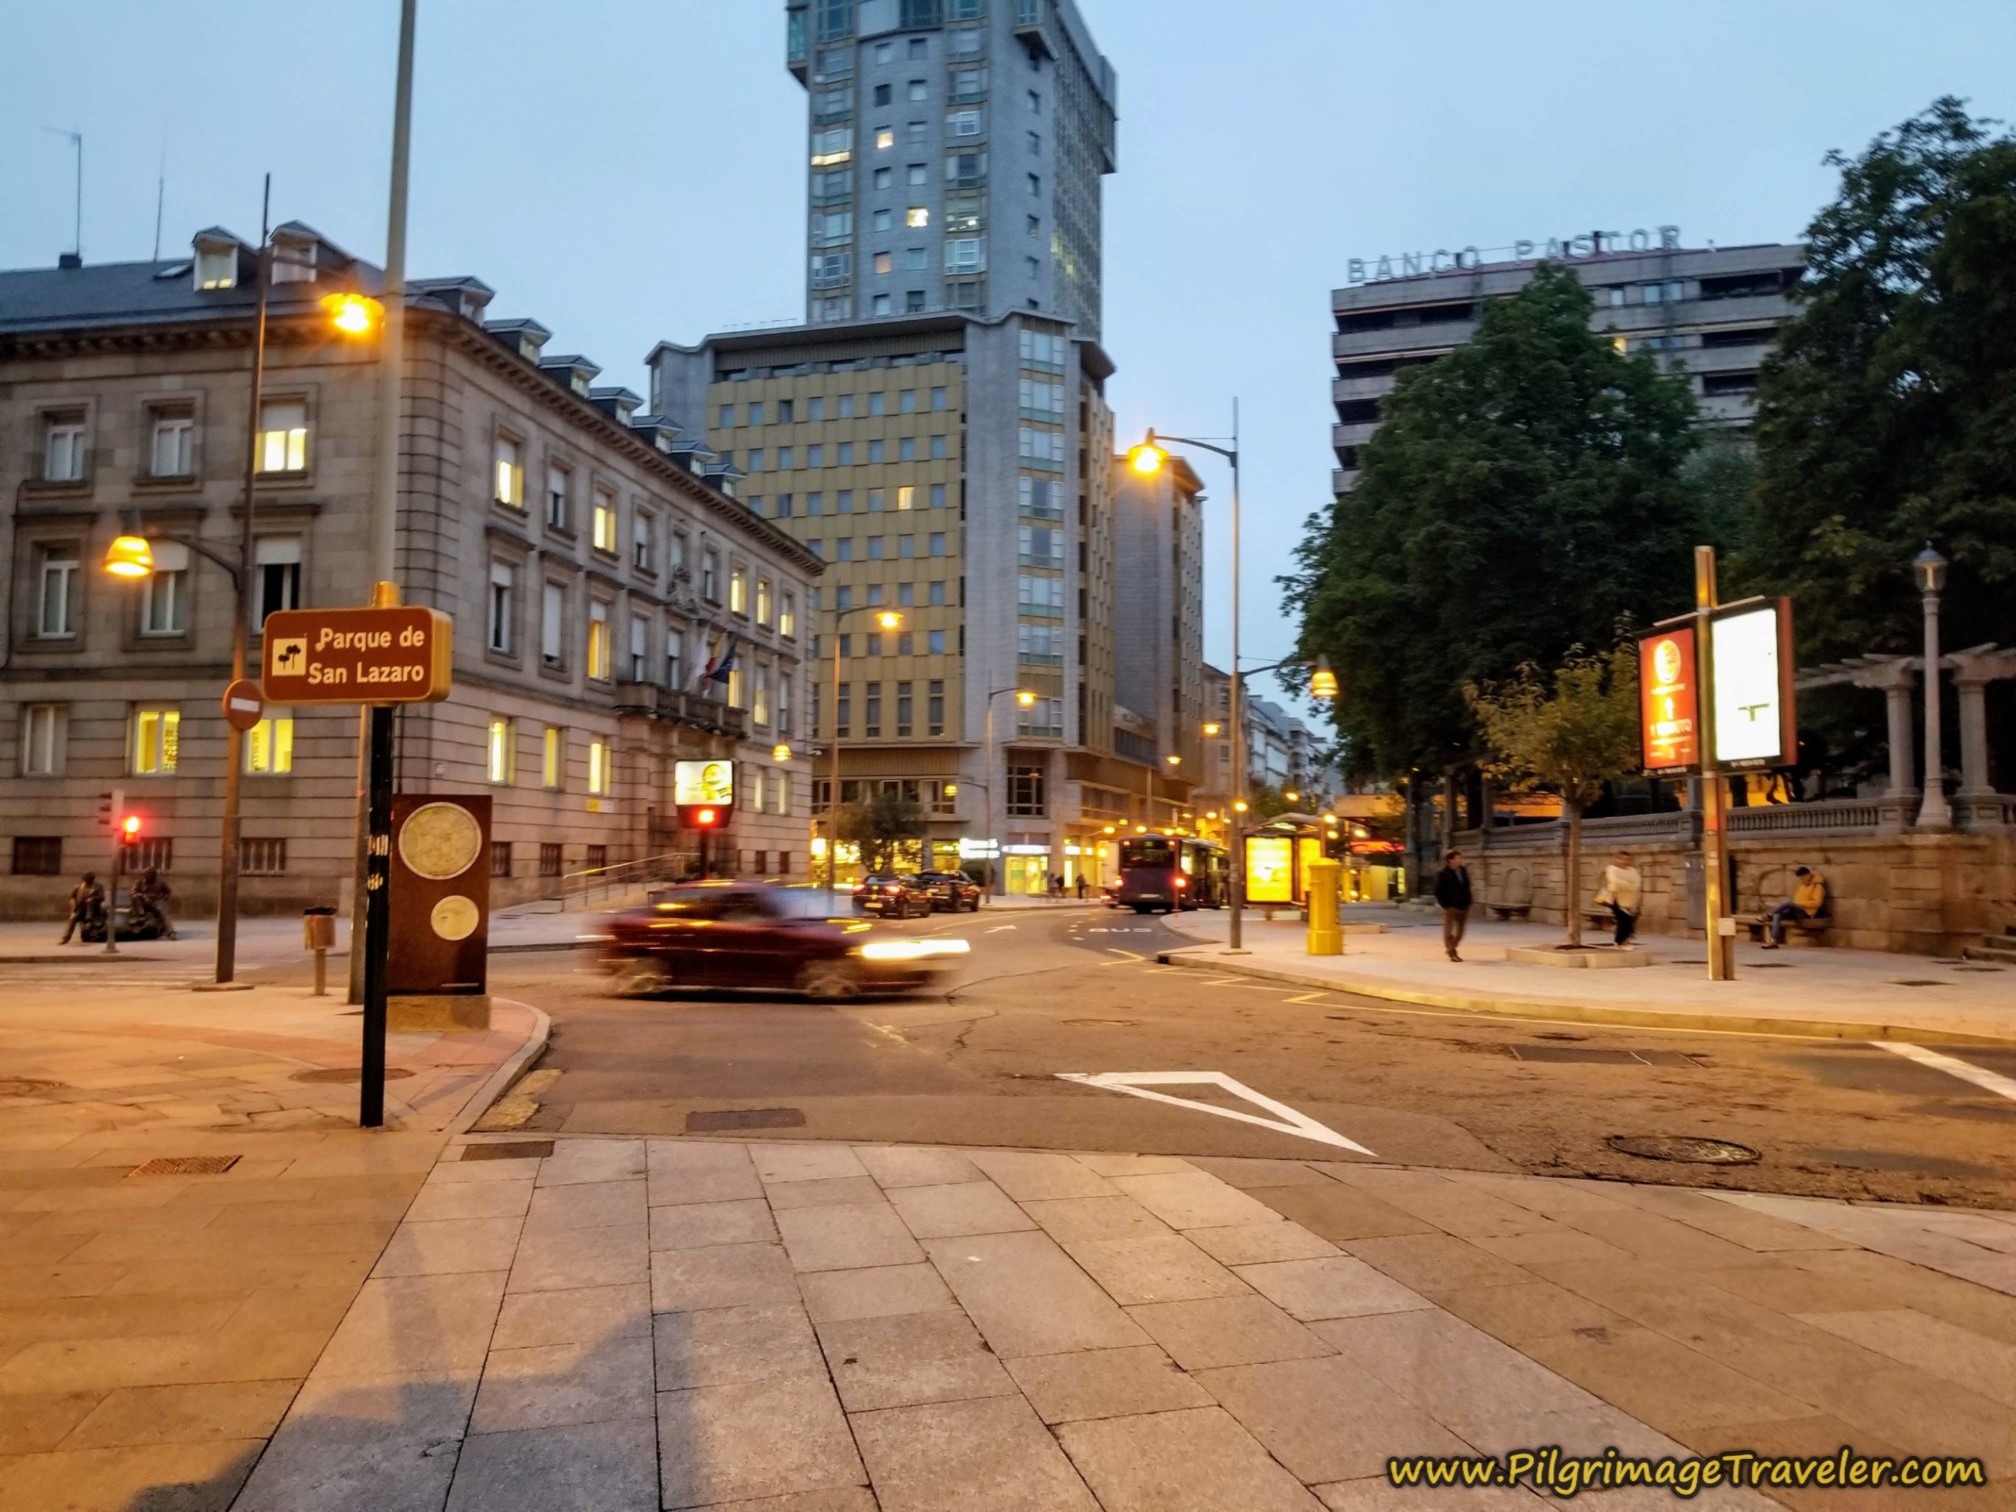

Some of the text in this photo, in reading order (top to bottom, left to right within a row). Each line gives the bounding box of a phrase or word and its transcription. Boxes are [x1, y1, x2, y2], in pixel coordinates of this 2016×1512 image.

[1347, 225, 1682, 284] BANCO PASTOR
[317, 625, 425, 653] Parque de
[307, 661, 425, 685] San Lazaro
